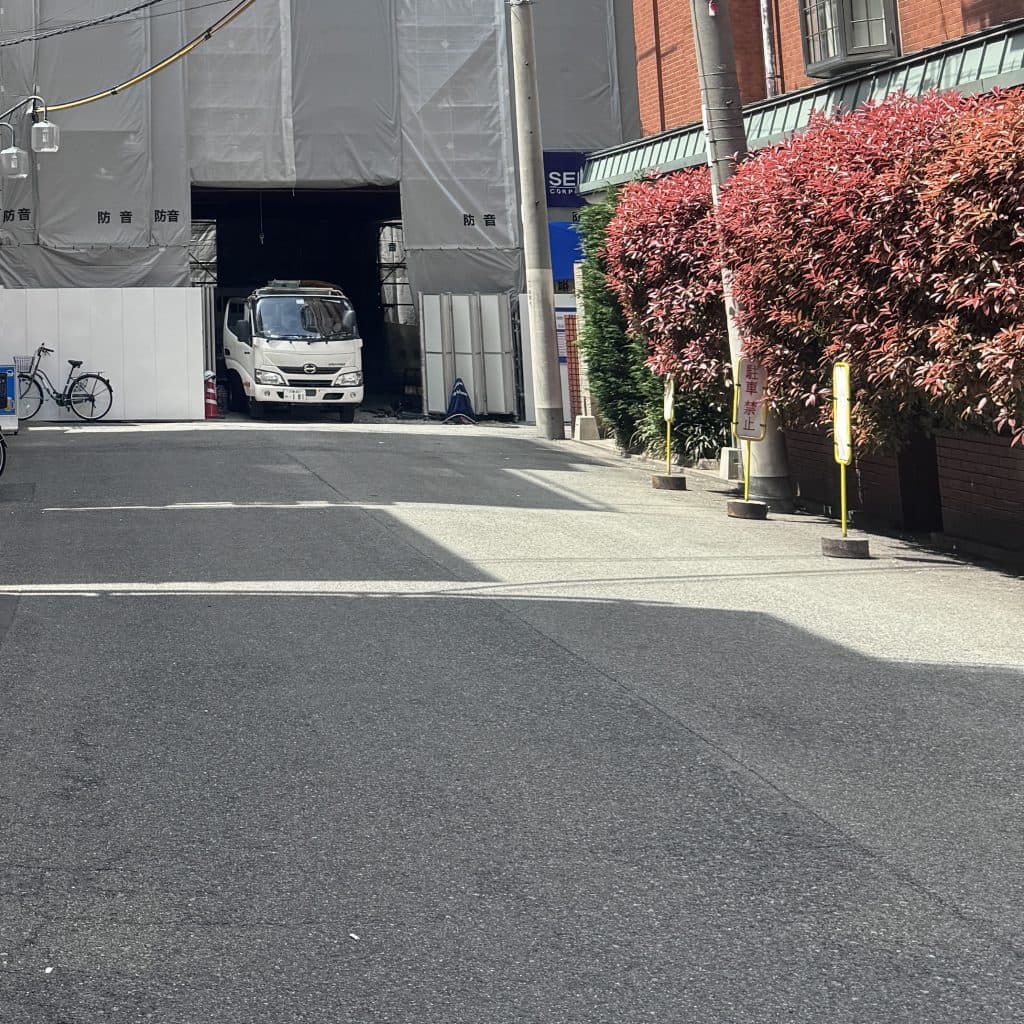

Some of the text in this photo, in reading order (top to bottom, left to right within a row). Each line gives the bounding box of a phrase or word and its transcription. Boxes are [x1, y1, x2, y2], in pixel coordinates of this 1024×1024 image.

[3, 208, 31, 222] 防音
[97, 210, 133, 224] 防音
[154, 209, 180, 223] 防音
[463, 213, 496, 226] 防音
[743, 363, 759, 431] 駐車禁止
